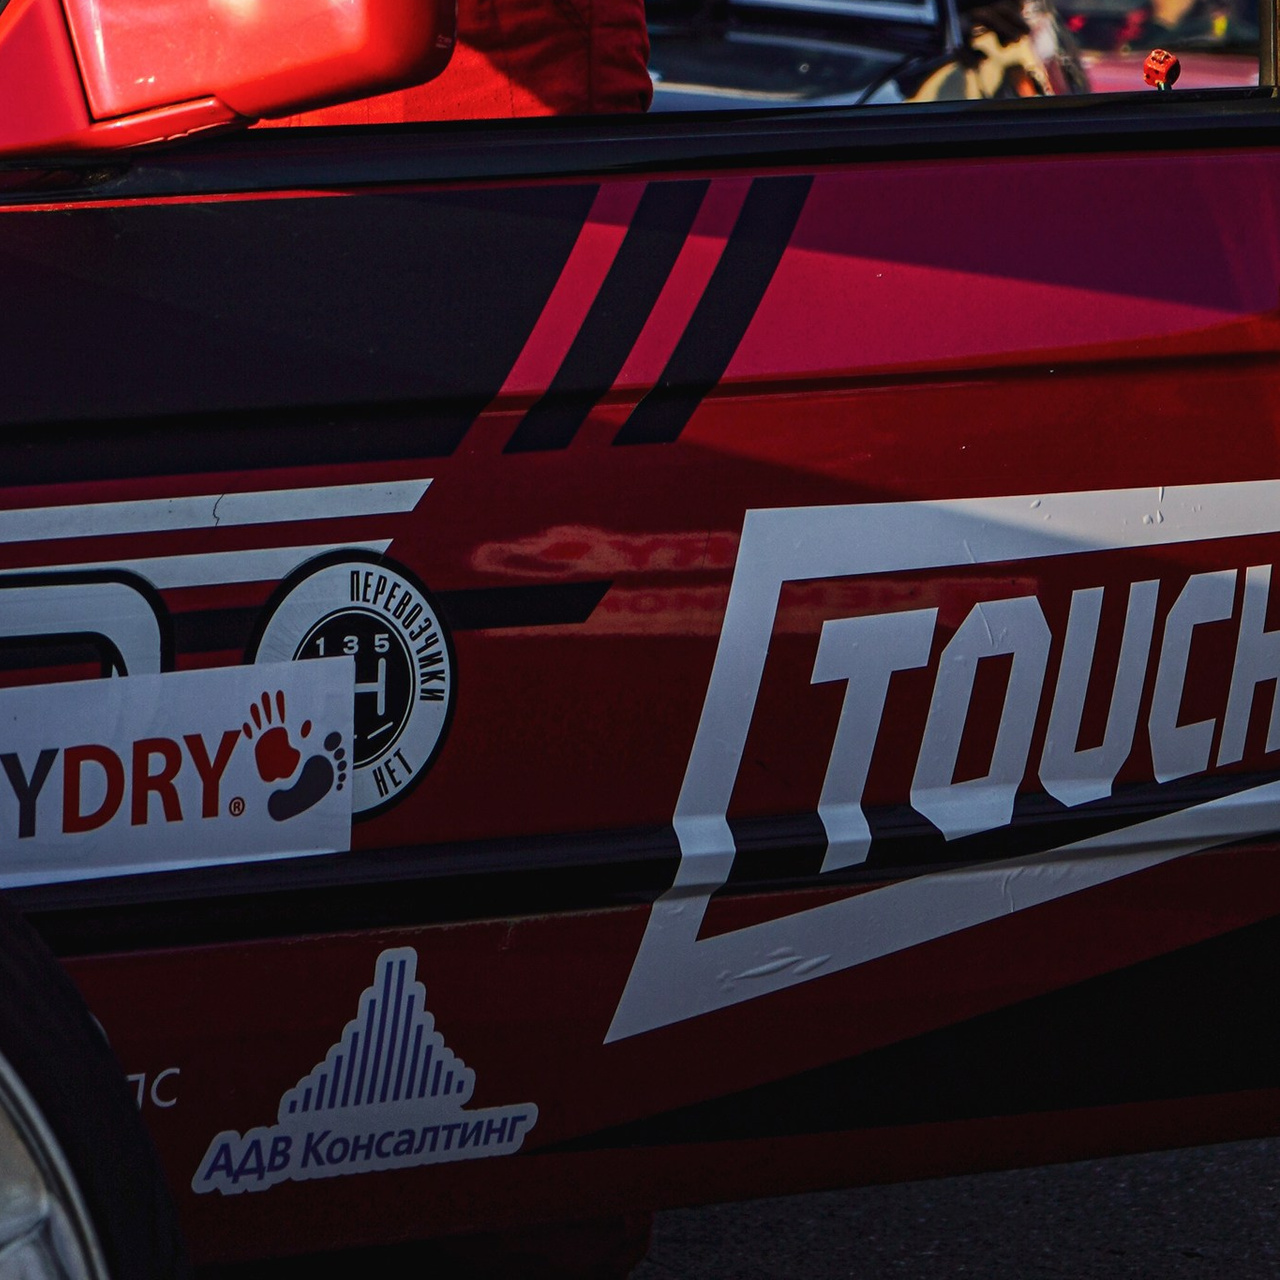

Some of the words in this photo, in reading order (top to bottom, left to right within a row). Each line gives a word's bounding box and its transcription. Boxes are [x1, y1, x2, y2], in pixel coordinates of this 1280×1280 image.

[315, 636, 326, 657] 1
[342, 634, 360, 656] 3
[373, 633, 391, 654] 5
[350, 570, 447, 702] ПЕРЕВОЗЧИКИ
[811, 563, 1280, 874] TOUCH
[372, 747, 413, 798] НЕТ
[204, 1134, 291, 1185] АДВ
[300, 1112, 528, 1173] Консалтинг
